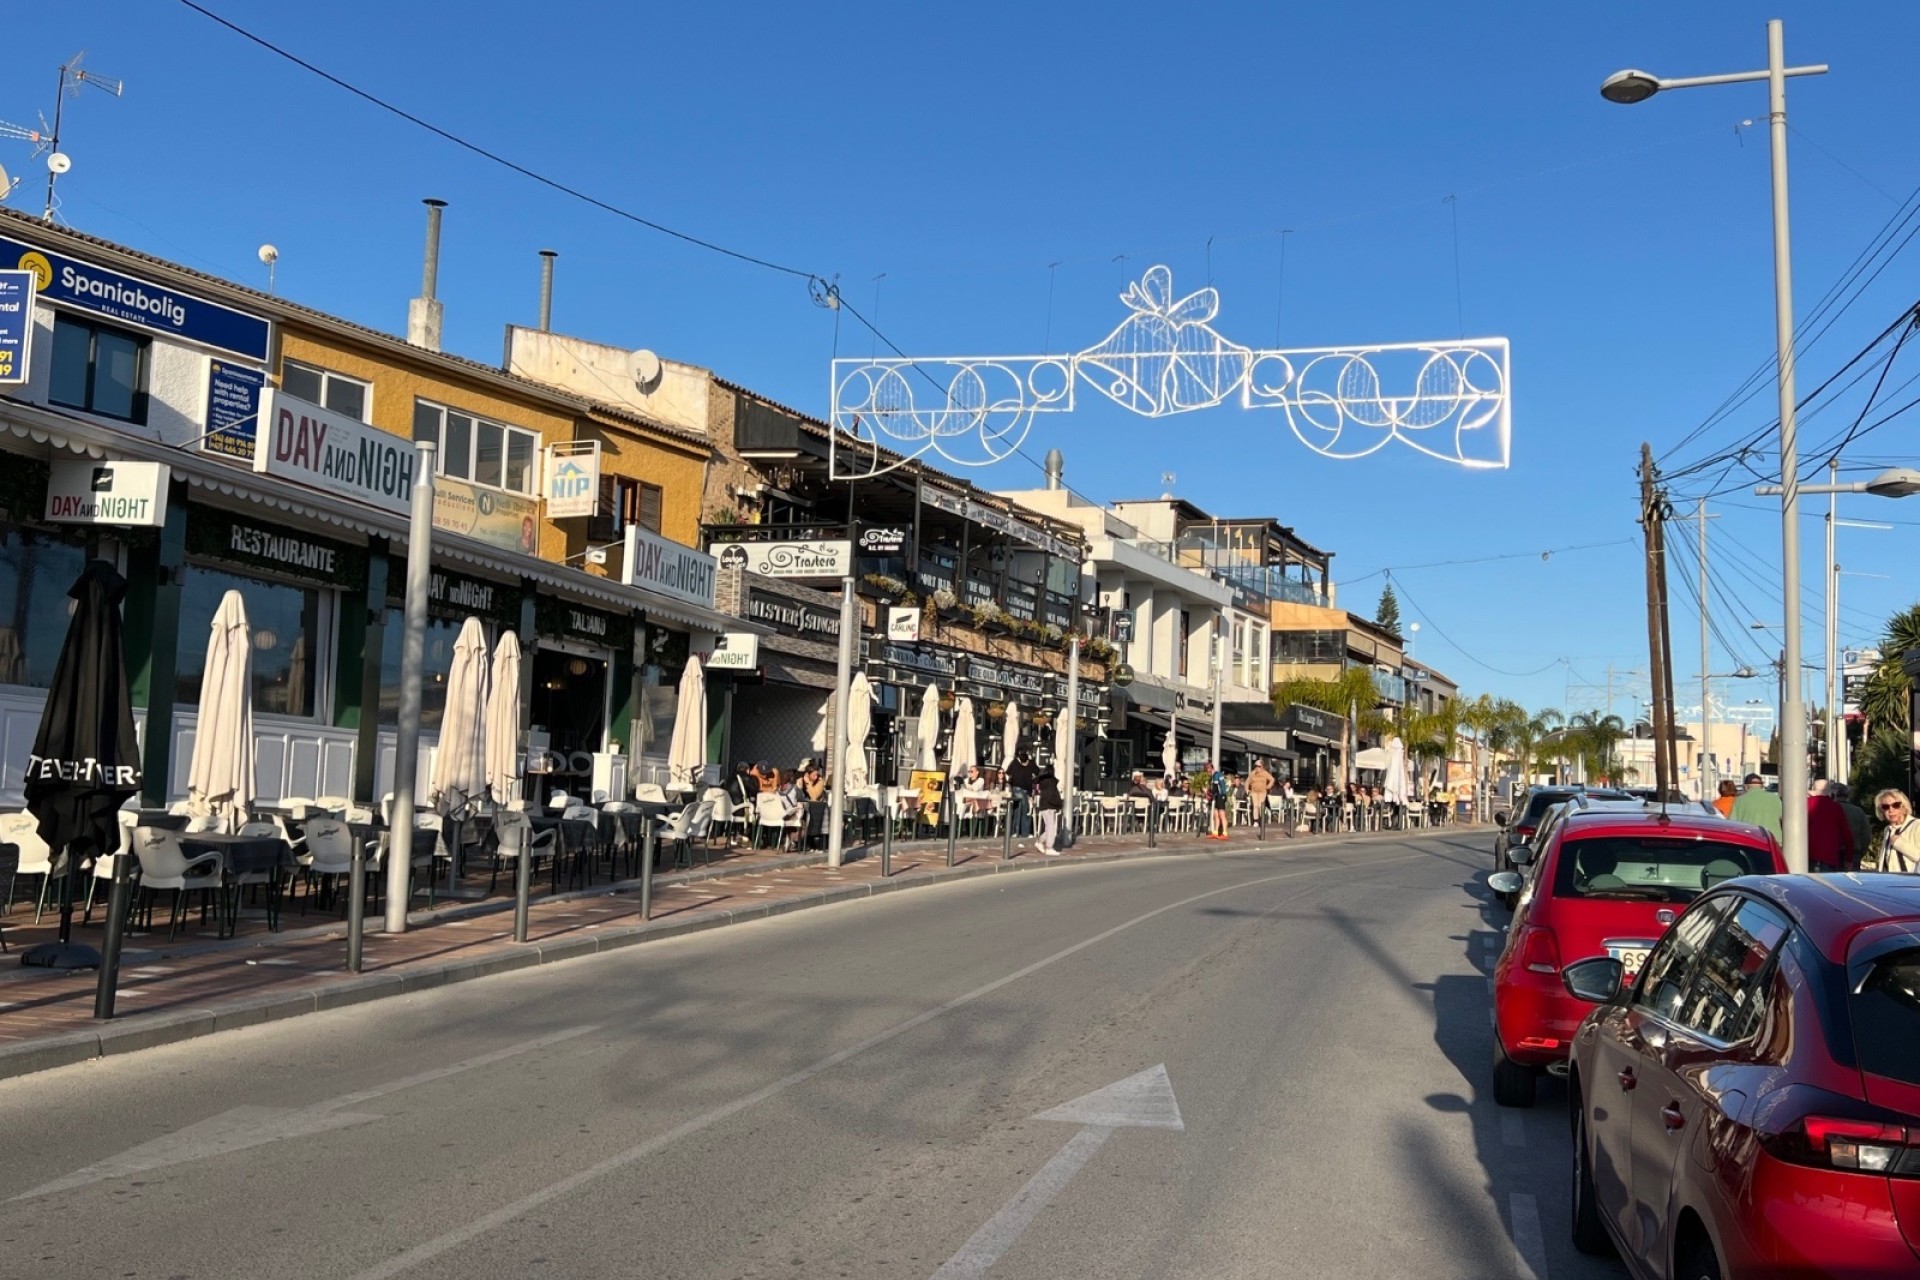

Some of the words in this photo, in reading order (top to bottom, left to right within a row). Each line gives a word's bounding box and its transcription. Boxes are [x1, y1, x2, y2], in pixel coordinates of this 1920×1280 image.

[61, 266, 186, 327] Spaniabolig
[101, 304, 119, 316] REAL
[121, 310, 146, 325] ESTATE
[275, 407, 328, 473] DAY
[323, 445, 356, 483] AND
[357, 436, 414, 502] NIGH
[447, 491, 475, 505] Services
[551, 477, 590, 499] NIP
[50, 495, 81, 517] DAY
[79, 504, 100, 518] AND
[101, 497, 149, 520] NIGHT
[230, 524, 336, 573] RESTAURANTE
[794, 555, 836, 568] Trastero
[635, 538, 662, 583] DAY
[659, 561, 676, 587] AND
[676, 554, 715, 600] NIGHT
[428, 573, 448, 600] AY
[749, 600, 800, 627] MISTER
[692, 651, 711, 665] AY
[720, 652, 750, 665] NIGHT
